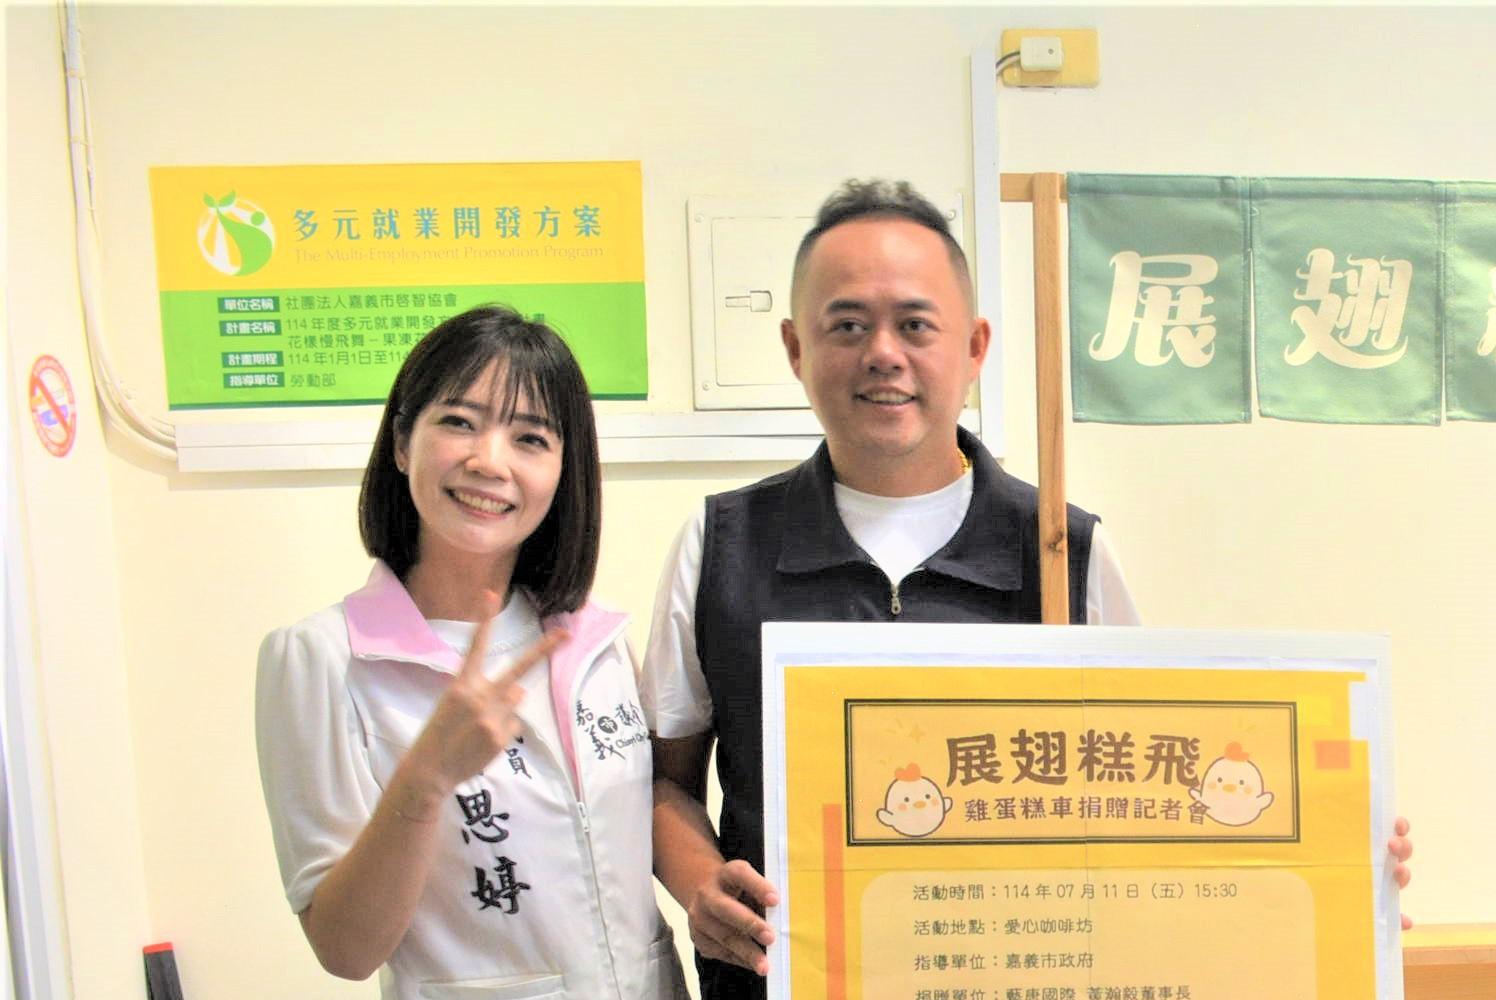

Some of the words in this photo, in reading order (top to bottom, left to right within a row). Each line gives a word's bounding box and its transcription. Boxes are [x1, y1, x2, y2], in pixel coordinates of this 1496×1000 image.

[293, 204, 602, 242] 多元就業開發方案
[296, 248, 321, 263] The
[464, 246, 540, 260] Promotion
[544, 244, 604, 261] Program
[290, 373, 336, 387] 勞動部
[946, 728, 1202, 788] 展翅糕飛
[964, 796, 1211, 826] 雞蛋糕車捐贈記者會
[456, 771, 531, 915] 思婷
